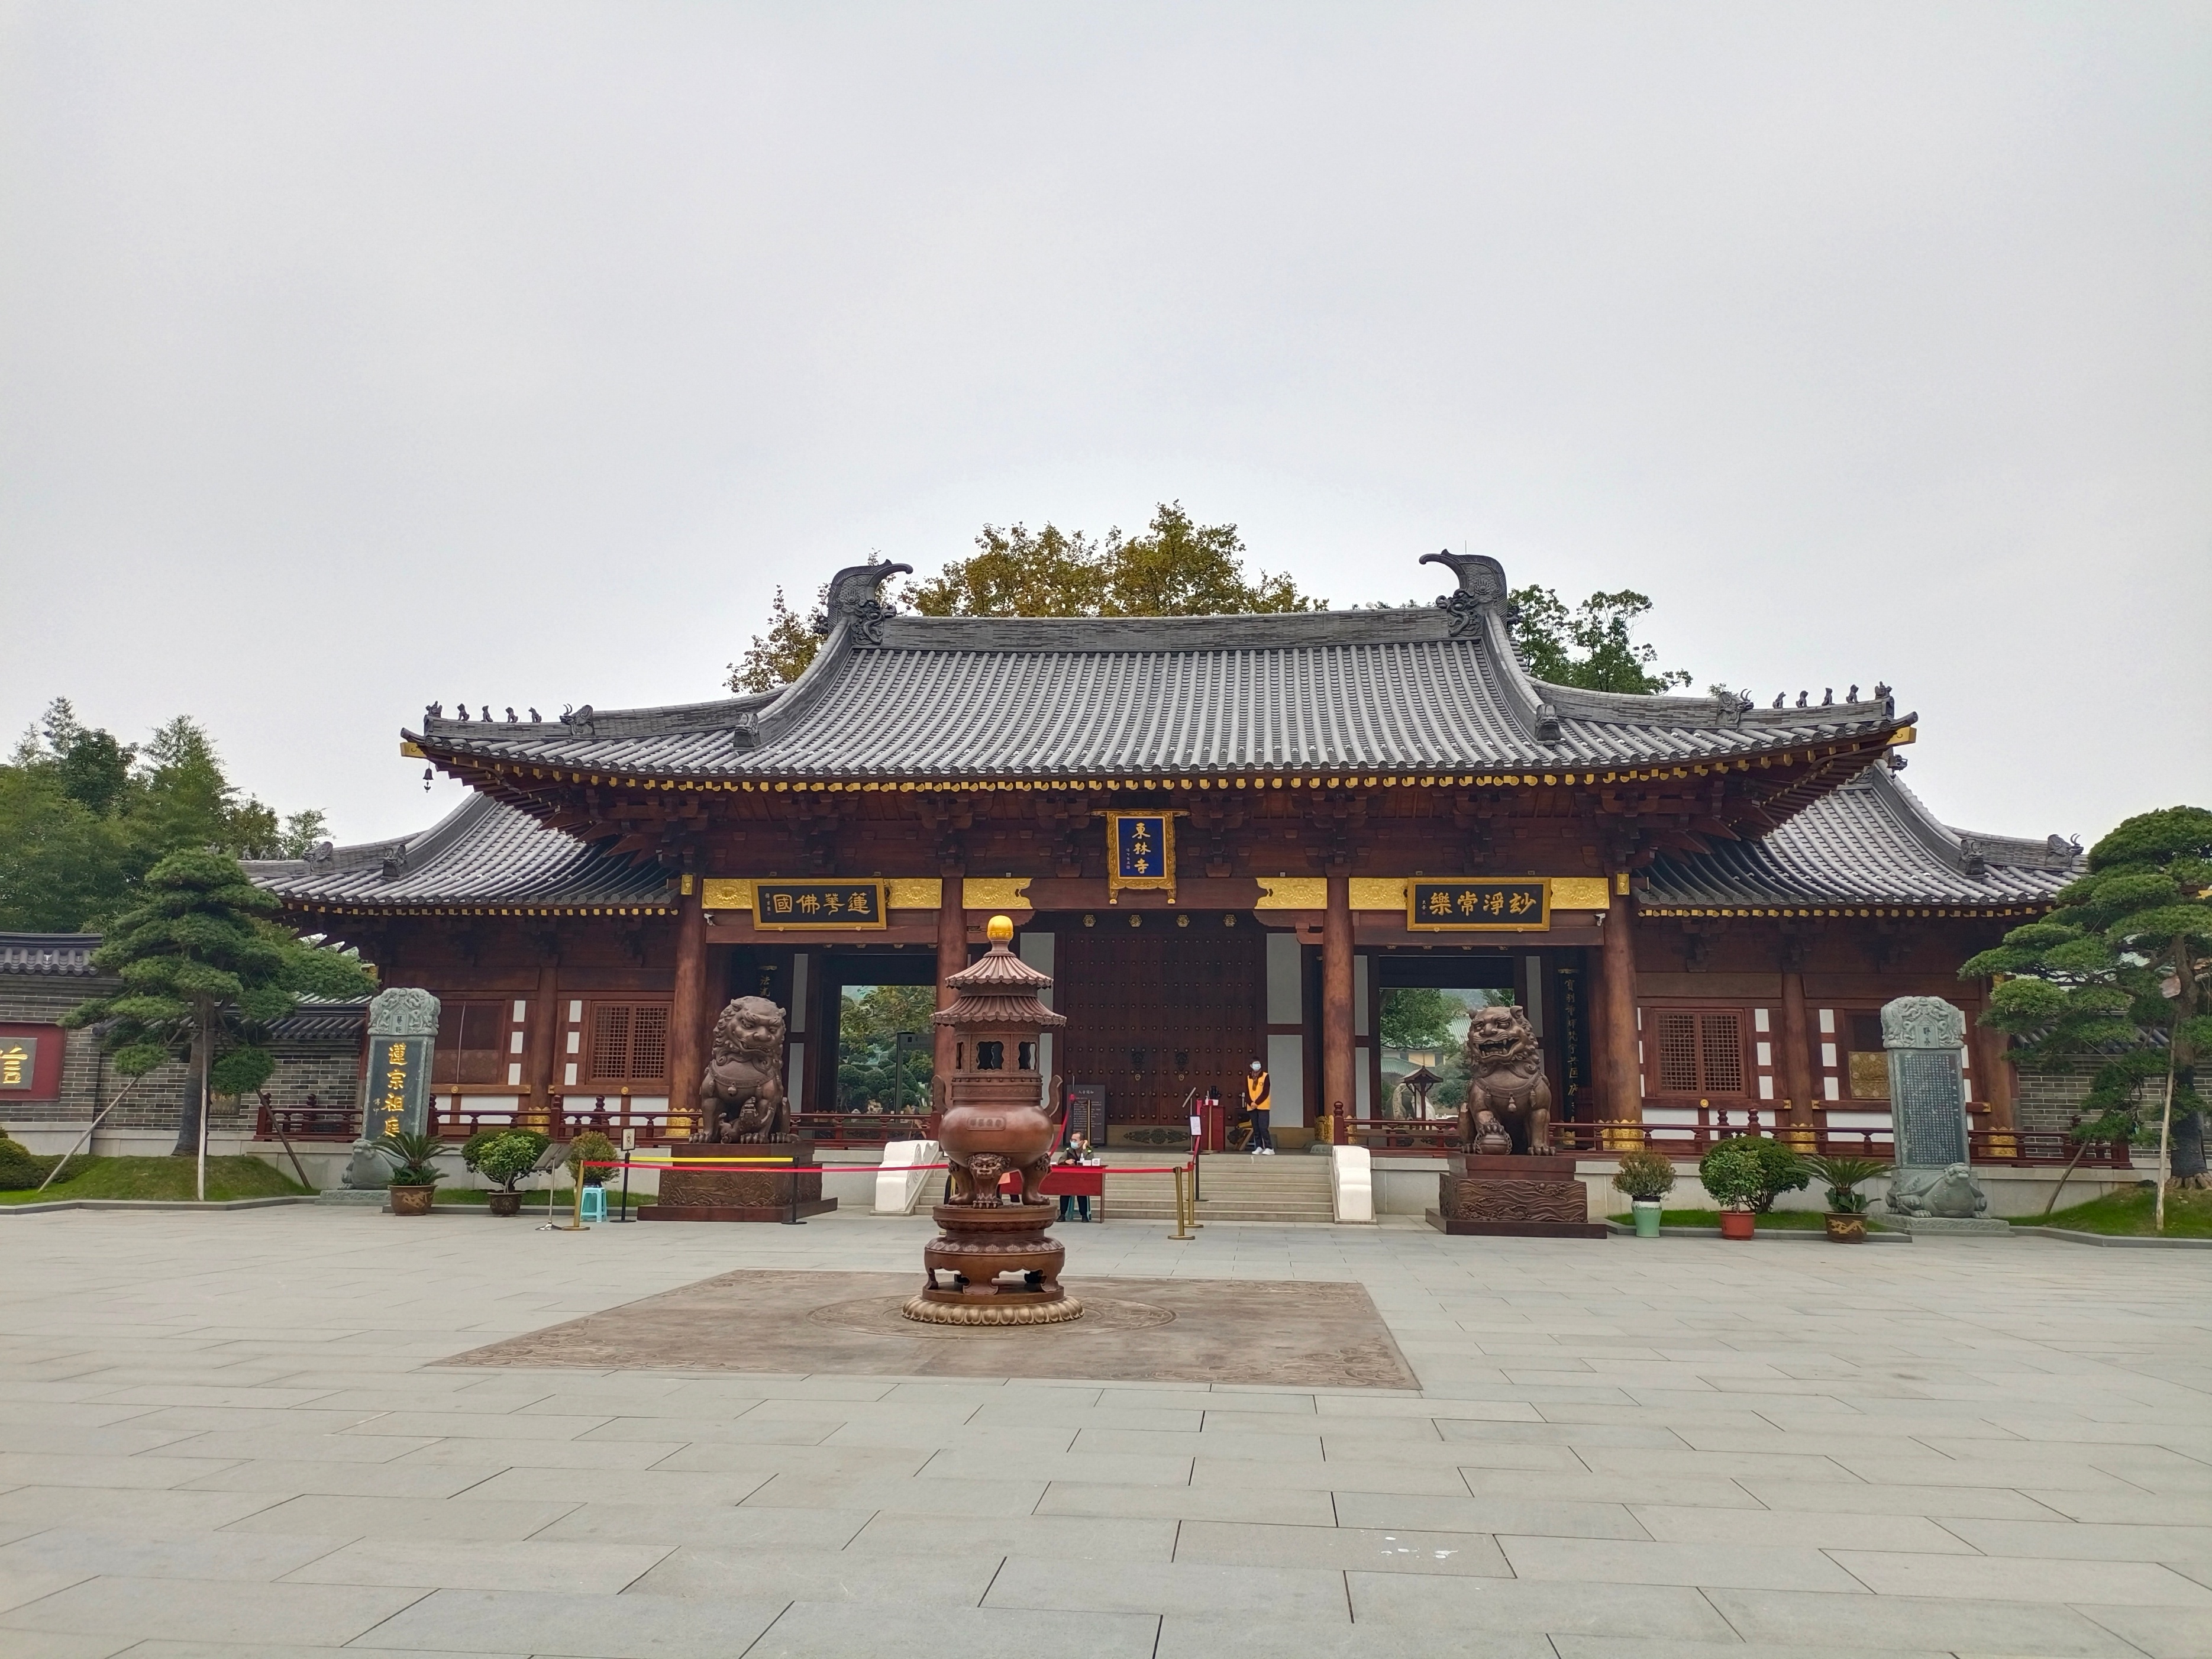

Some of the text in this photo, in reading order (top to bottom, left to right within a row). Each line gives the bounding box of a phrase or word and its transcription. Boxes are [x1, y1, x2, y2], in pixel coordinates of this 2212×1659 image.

[1132, 822, 1151, 874] 東林寺
[773, 892, 871, 916] 蓮華佛國
[380, 1042, 407, 1137] 蓮宗祖庭
